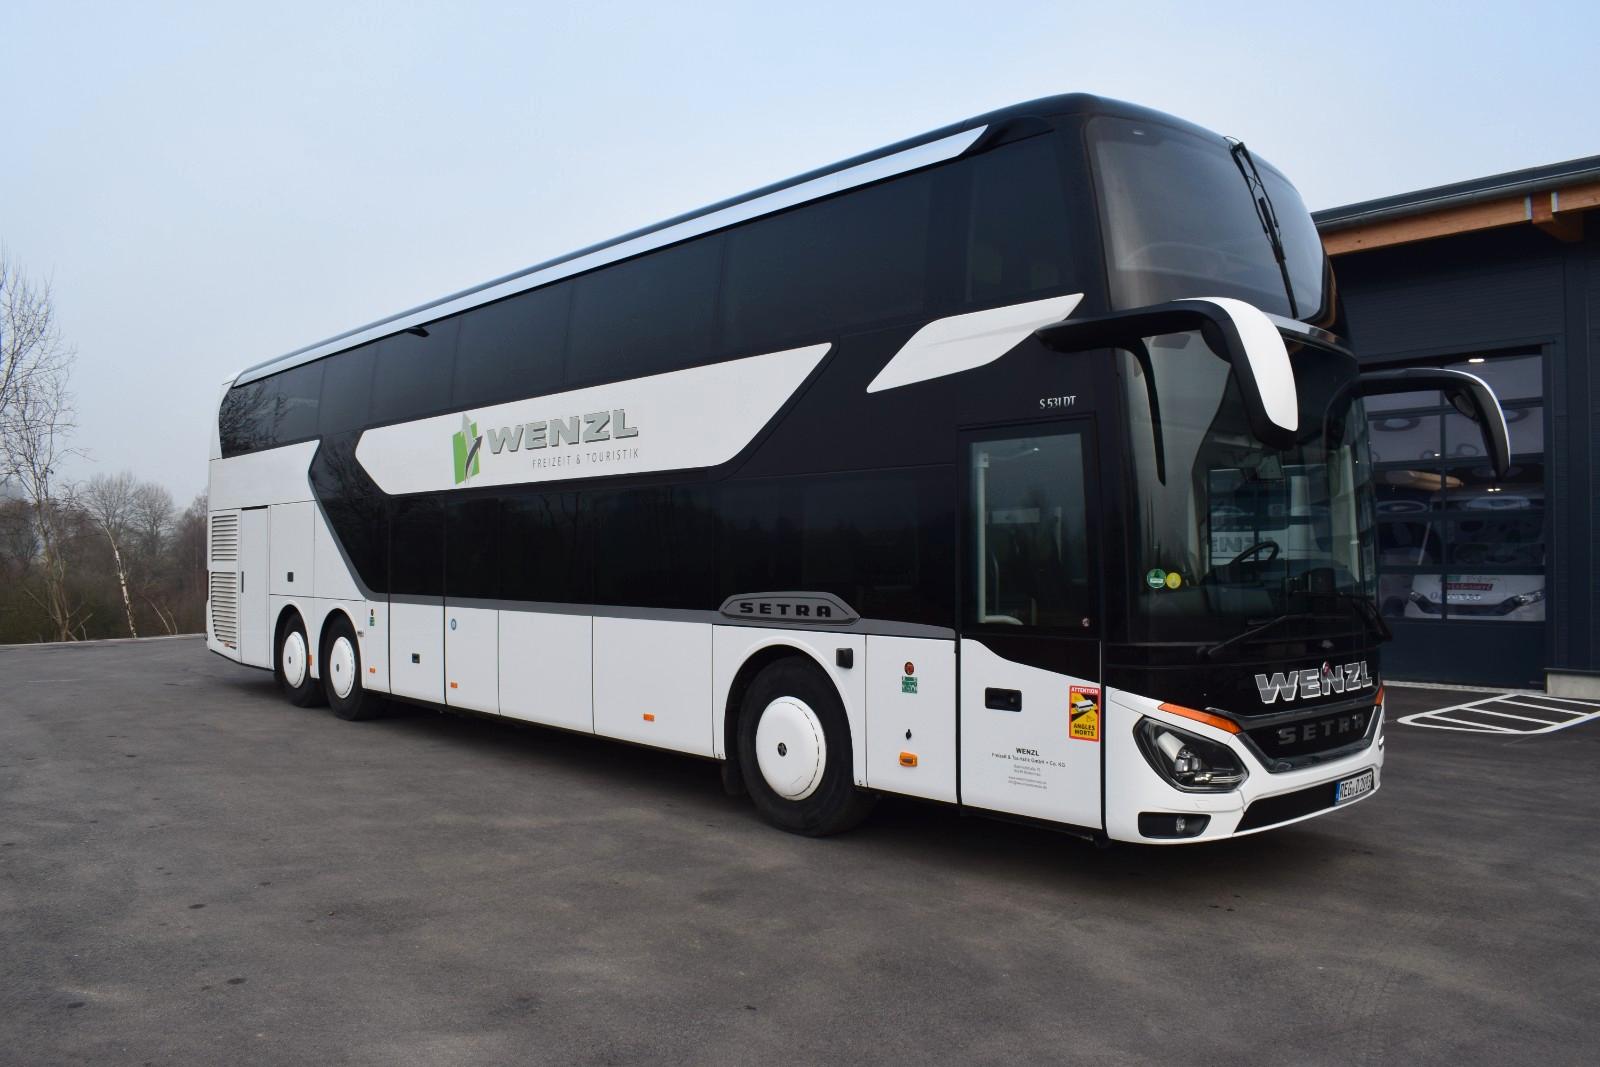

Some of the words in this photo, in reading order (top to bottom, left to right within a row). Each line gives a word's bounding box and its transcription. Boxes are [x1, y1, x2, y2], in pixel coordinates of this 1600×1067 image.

[1039, 398, 1046, 410] S
[1047, 397, 1062, 409] 531
[1063, 395, 1077, 407] DT
[486, 409, 639, 455] WENZL
[532, 455, 572, 469] FREIZEIT
[576, 454, 581, 465] &
[586, 448, 639, 463] TOURISTIK
[740, 602, 832, 618] SETRA
[1254, 661, 1373, 704] WENZL
[1278, 714, 1365, 745] SETRA
[1016, 747, 1040, 757] WENZL
